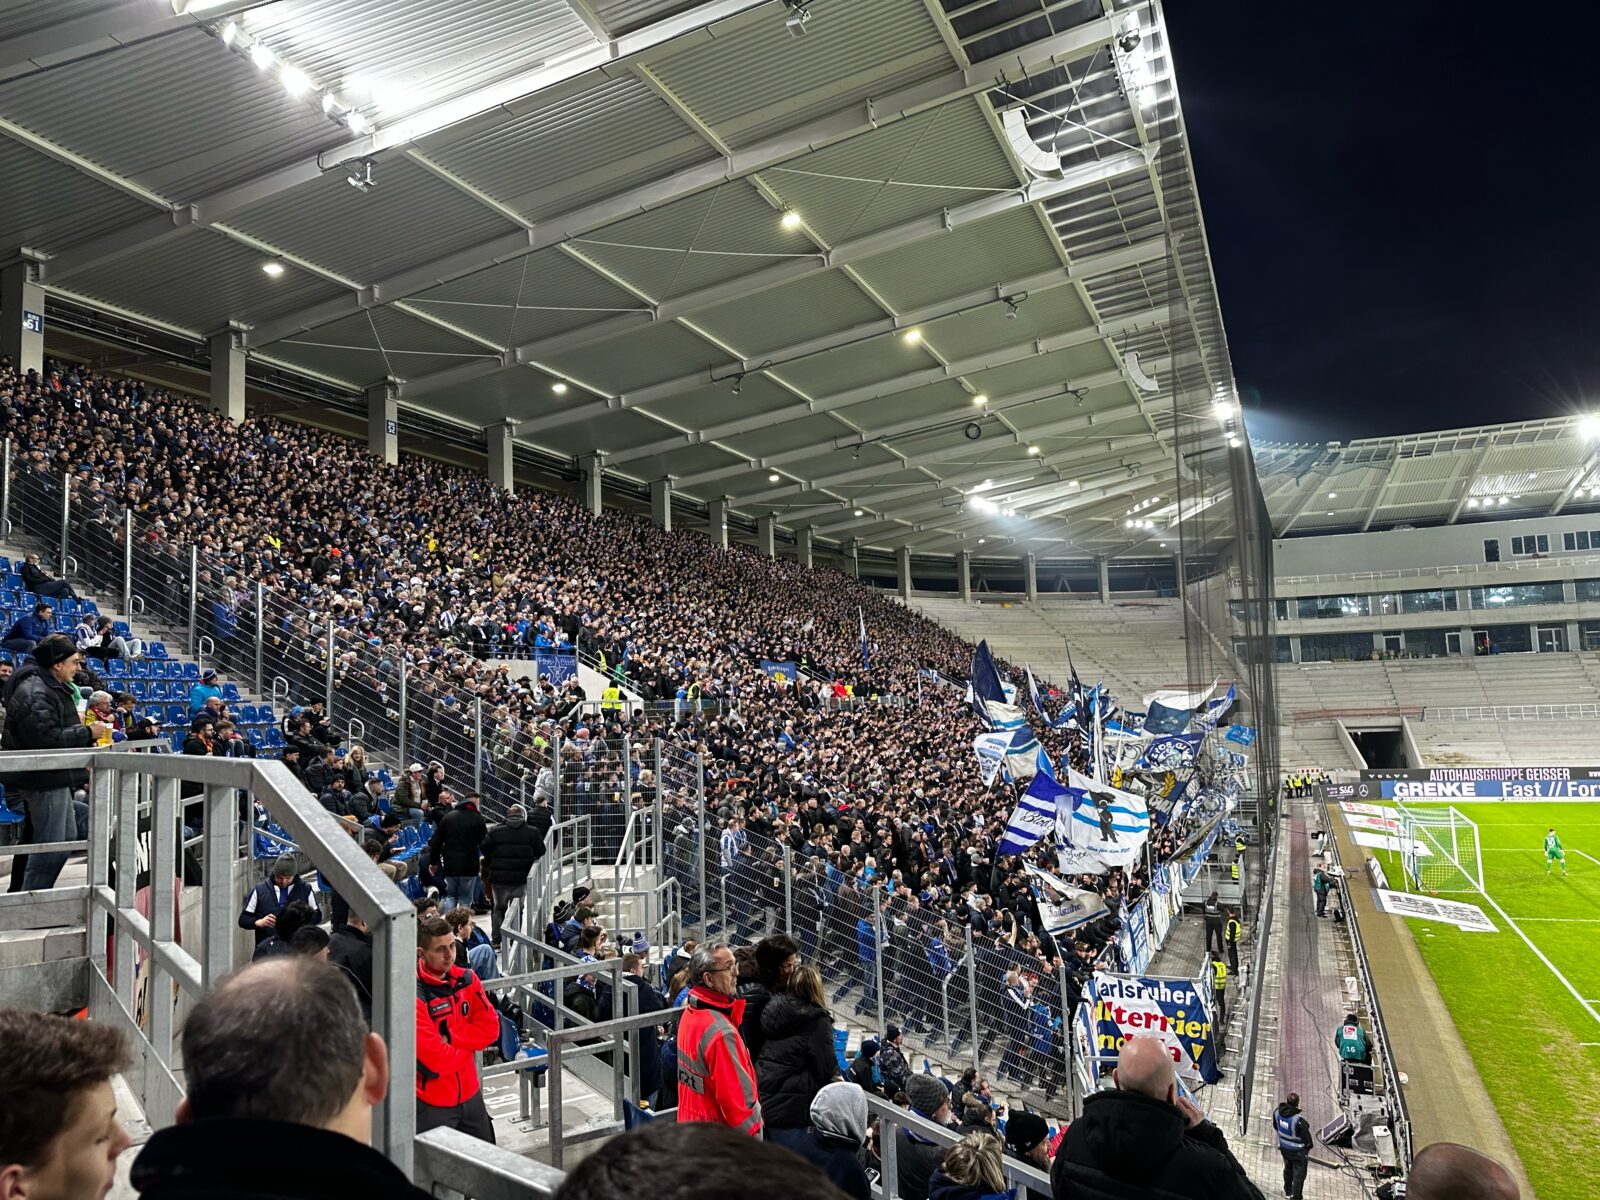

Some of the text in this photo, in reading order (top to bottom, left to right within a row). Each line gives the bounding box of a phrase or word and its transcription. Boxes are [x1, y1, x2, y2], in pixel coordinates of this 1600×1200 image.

[1429, 768, 1571, 781] AUTOHAUSGRUPPE GEISSER
[1339, 785, 1355, 795] S&G
[1393, 782, 1476, 797] GRENKE
[1501, 782, 1542, 797] Fast
[1566, 781, 1600, 797] For
[1097, 978, 1196, 1007] arlsruher
